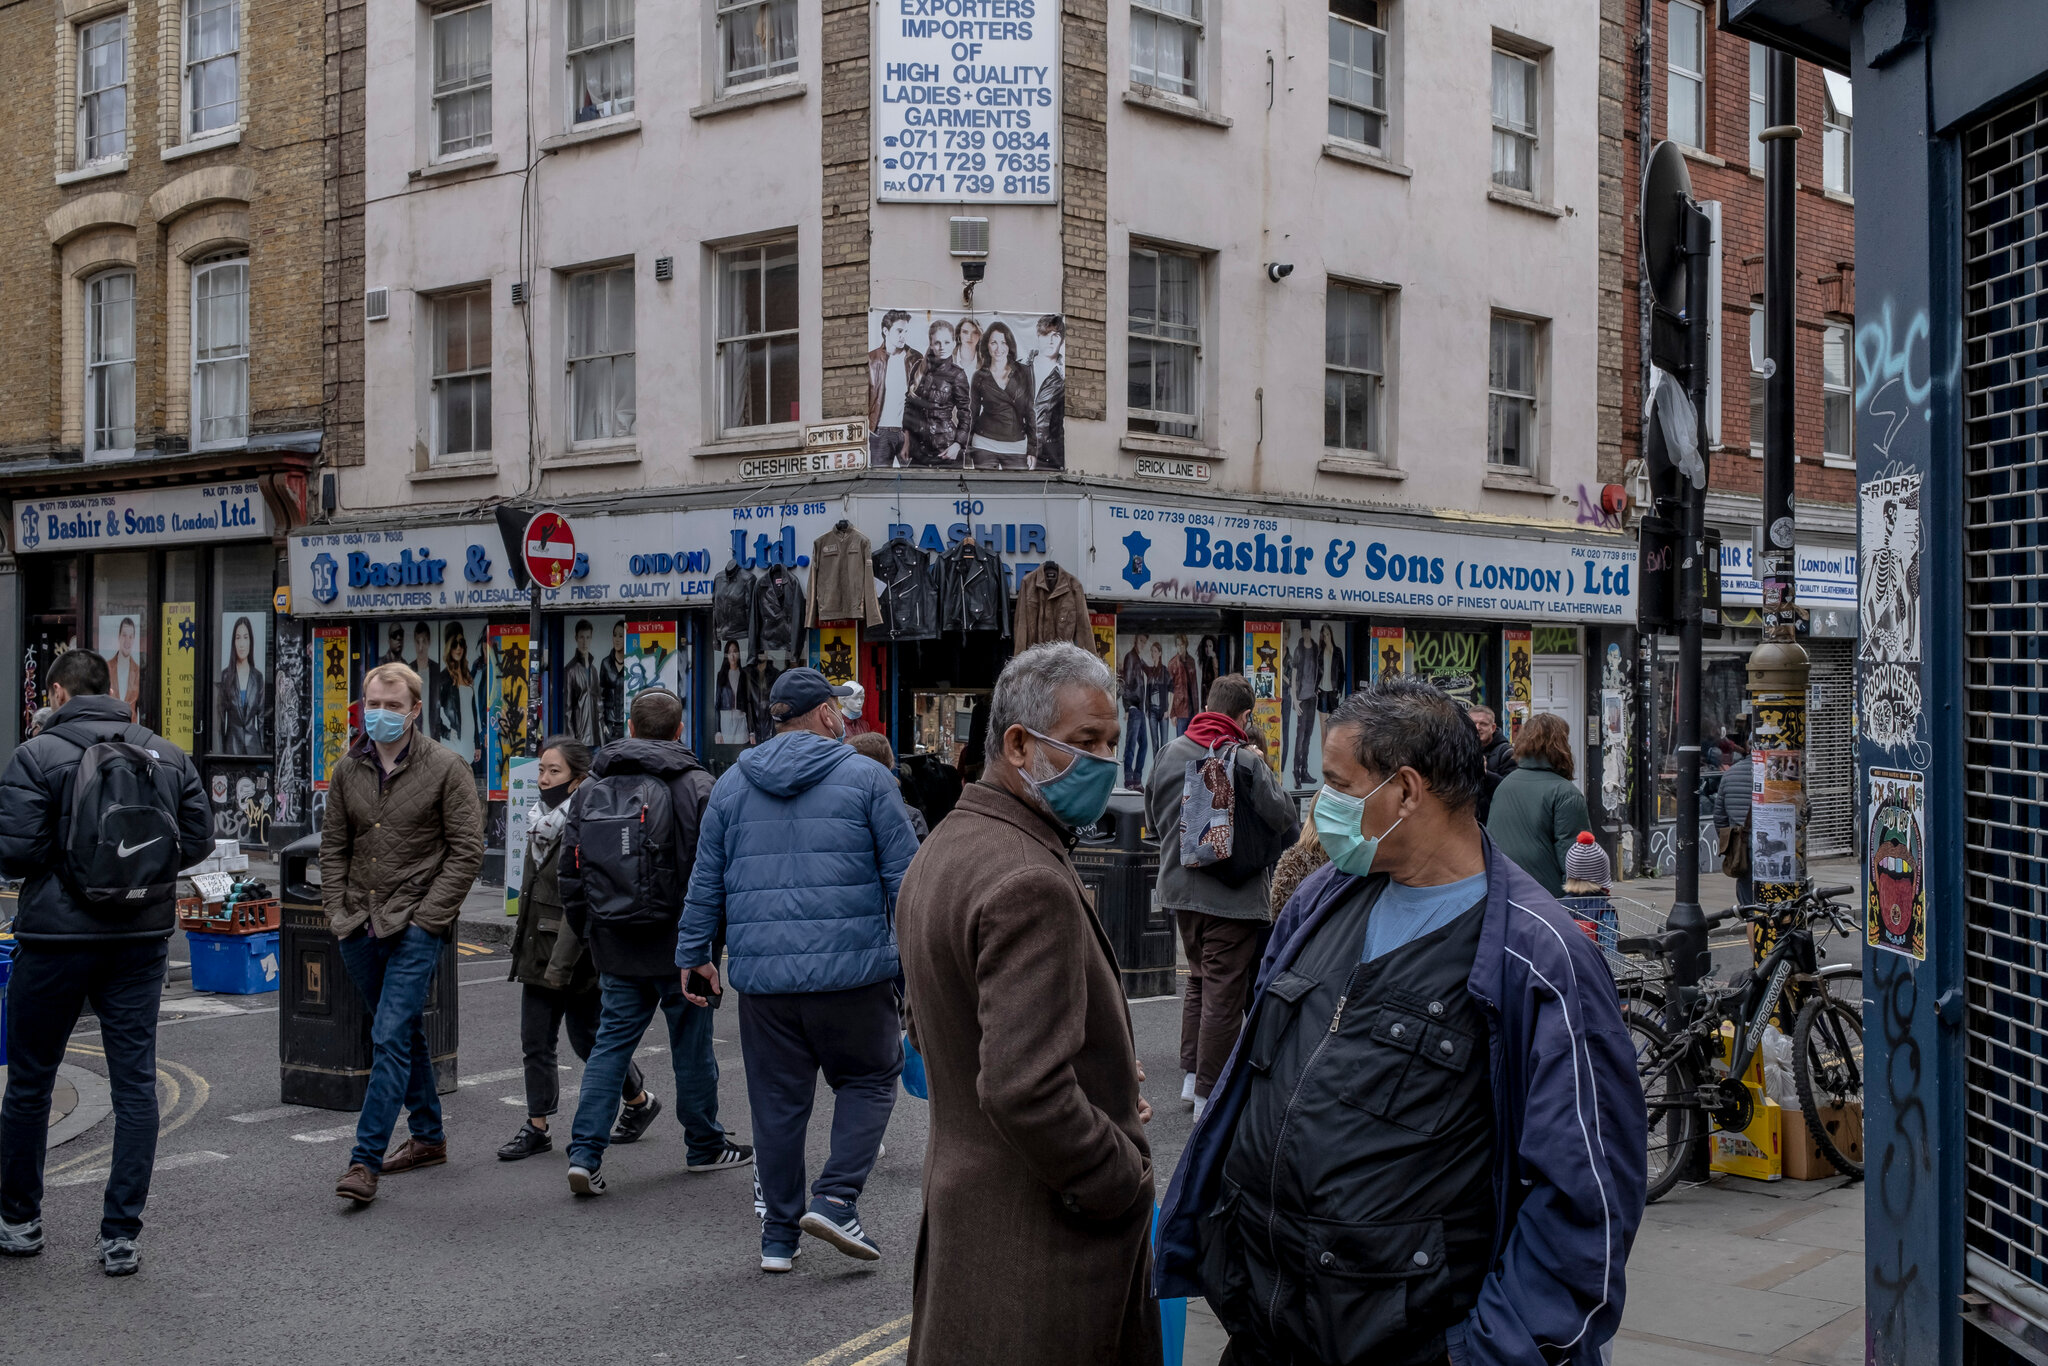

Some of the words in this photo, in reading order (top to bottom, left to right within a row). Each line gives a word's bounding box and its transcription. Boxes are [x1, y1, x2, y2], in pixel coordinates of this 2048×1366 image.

[900, 0, 1035, 19] EXPORTERS
[902, 19, 1033, 41] IMPORTERS
[951, 42, 983, 61] OF
[886, 63, 939, 82] HIGH
[953, 65, 1048, 84] QUALITY
[883, 85, 961, 105] LADIES
[976, 87, 1052, 106] GENTS
[904, 107, 1031, 129] GARMENTS
[900, 129, 937, 148] 071
[944, 131, 985, 149] 739
[992, 132, 1050, 150] 0834
[900, 151, 937, 170] 071
[944, 152, 986, 171] 729
[995, 153, 1050, 172] 7635
[884, 181, 906, 191] FAX
[908, 173, 945, 192] 071
[953, 174, 994, 193] 739
[1004, 175, 1050, 194] 8115
[743, 457, 807, 475] CHESHIRE
[812, 455, 829, 470] ST.
[1138, 460, 1165, 474] BRICK
[1169, 462, 1194, 477] LANE
[202, 487, 216, 497] FAX
[1871, 478, 1909, 499] RIDER
[733, 507, 752, 520] FAX
[756, 506, 774, 518] 071
[779, 504, 799, 517] 739
[803, 502, 826, 515] 8115
[952, 500, 984, 515] 180
[47, 511, 102, 540] Bashir
[106, 509, 120, 537] &
[124, 507, 165, 535] Sons
[172, 508, 218, 532] (London)
[220, 497, 256, 527] Ltd.
[1109, 506, 1130, 518] TEL
[1133, 509, 1154, 521] 020
[1157, 511, 1185, 524] 7739
[1188, 514, 1215, 527] 0834
[1224, 516, 1250, 529] 7729
[1253, 519, 1278, 532] 7635
[311, 536, 323, 546] 071
[326, 535, 340, 546] 739
[347, 546, 447, 588] Bashir
[464, 544, 493, 584] &
[730, 525, 810, 570] Ltd.
[1183, 526, 1314, 576] Bashir
[1324, 538, 1356, 578] &
[1365, 542, 1445, 585] Sons
[1583, 560, 1630, 597] Ltd
[1571, 548, 1586, 558] FAX
[1587, 549, 1601, 559] 020
[1602, 550, 1620, 560] 7739
[1621, 552, 1637, 561] 8115
[1720, 546, 1741, 567] HIR
[1798, 553, 1843, 577] (LONDON)
[1844, 556, 1857, 575] LT
[347, 591, 432, 608] MANUFACTURERS
[440, 591, 447, 605] &
[545, 588, 560, 600] OF
[571, 584, 611, 600] FINEST
[619, 581, 671, 599] QUALITY
[1196, 580, 1323, 599] MANUFACTURERS
[1327, 589, 1337, 601] &
[1340, 589, 1434, 605] WHOLESALERS
[1437, 595, 1454, 606] OF
[1457, 596, 1497, 609] FINEST
[1500, 598, 1545, 612] QUALITY
[1547, 601, 1622, 615] LEATHERWEAR
[1799, 585, 1820, 593] QUALITY
[1820, 585, 1855, 595] LEATHERWEAR
[1890, 663, 1921, 712] KEBAB
[177, 700, 193, 708] PUBLI
[182, 713, 193, 722] Day
[621, 826, 631, 855] THULE
[1075, 855, 1105, 864] LITTER
[1749, 960, 1792, 1047] SHOCKWAVE
